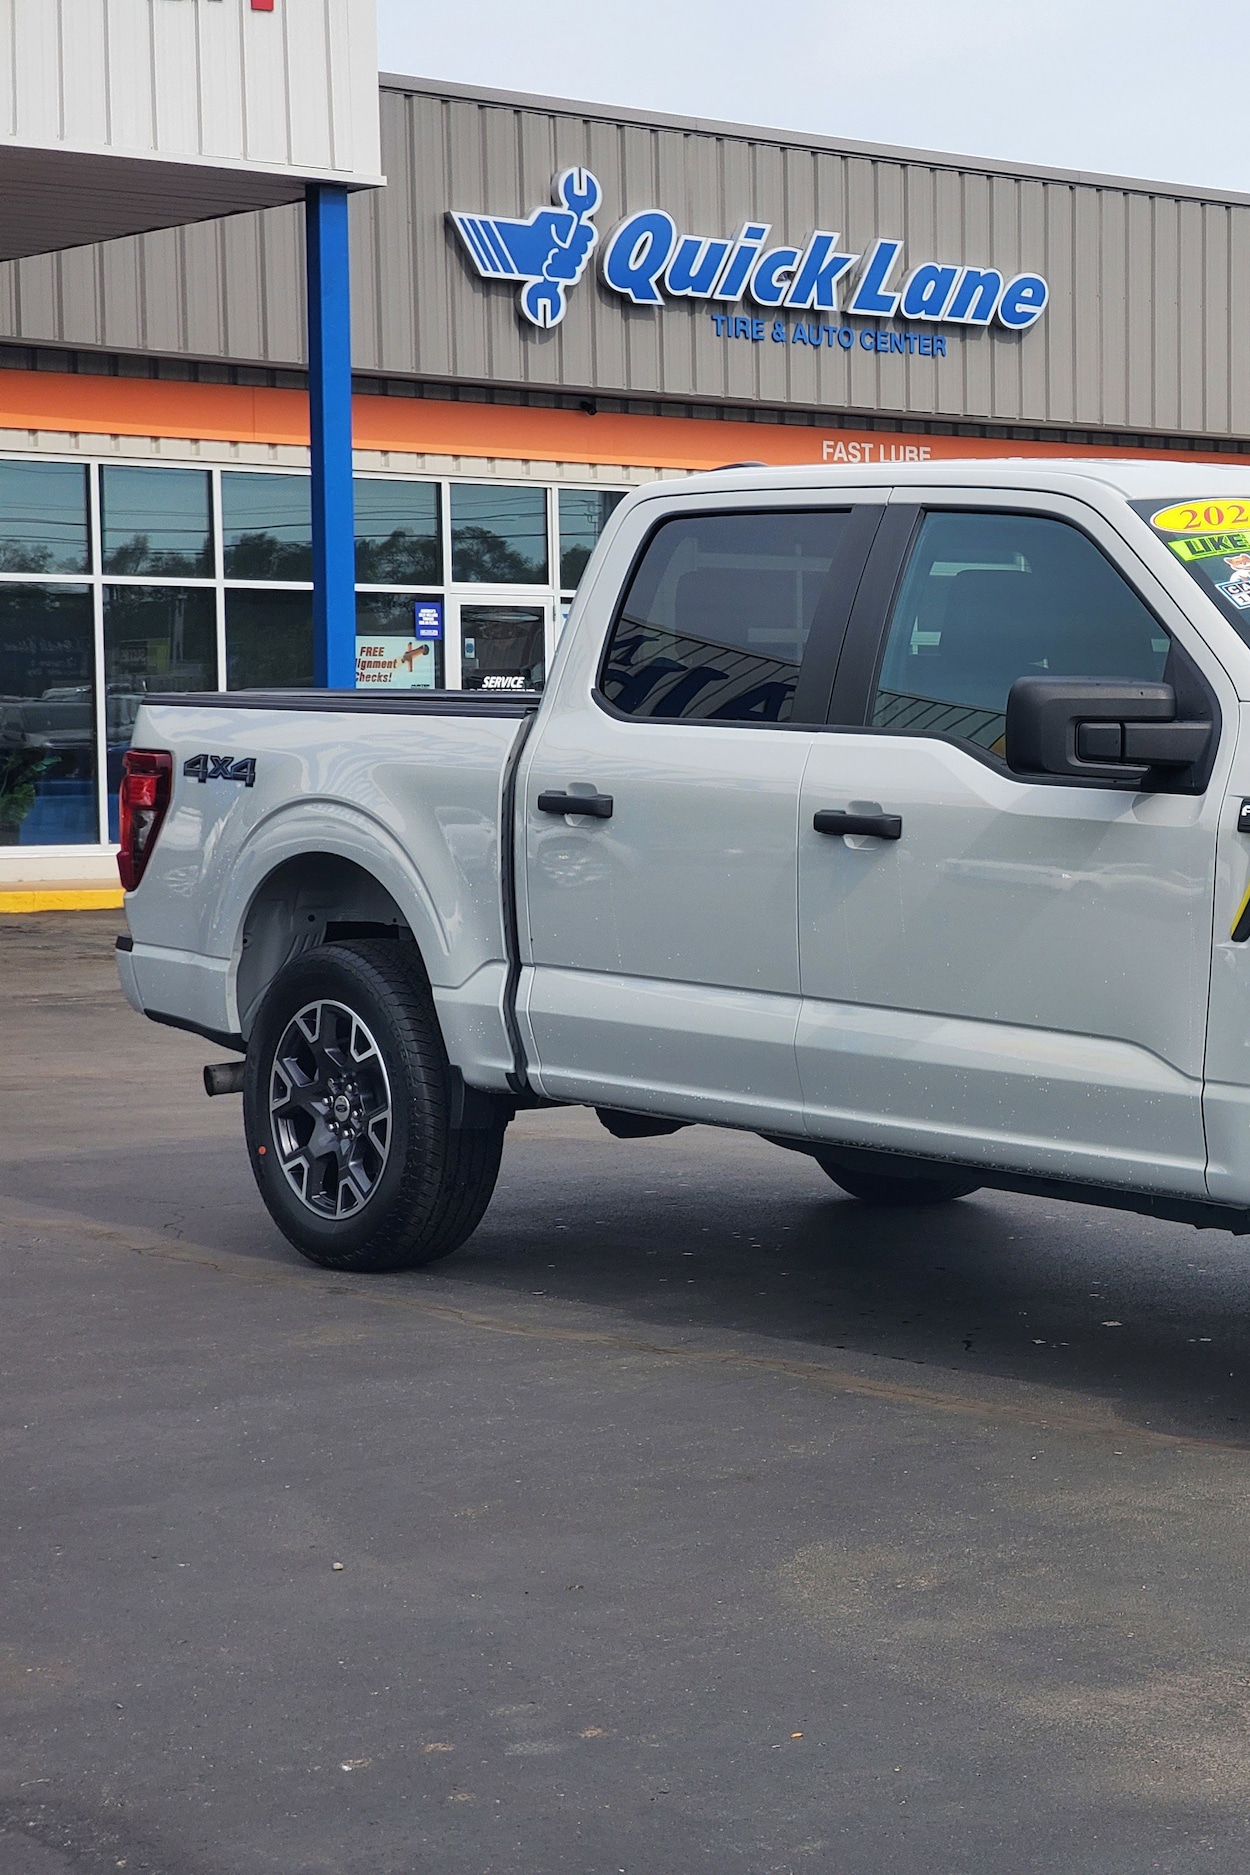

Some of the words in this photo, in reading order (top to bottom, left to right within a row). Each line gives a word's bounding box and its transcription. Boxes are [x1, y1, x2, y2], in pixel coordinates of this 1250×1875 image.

[603, 208, 860, 311] Quick
[847, 237, 1049, 330] Lane
[712, 314, 765, 341] TIRE
[771, 320, 786, 343] &
[792, 321, 854, 349] AUTO
[859, 328, 947, 357] CENTER
[822, 440, 874, 463] FAST
[1184, 533, 1250, 556] LIKE
[360, 646, 385, 657] FREE
[355, 658, 397, 671] lignment
[481, 676, 525, 689] SERVICE
